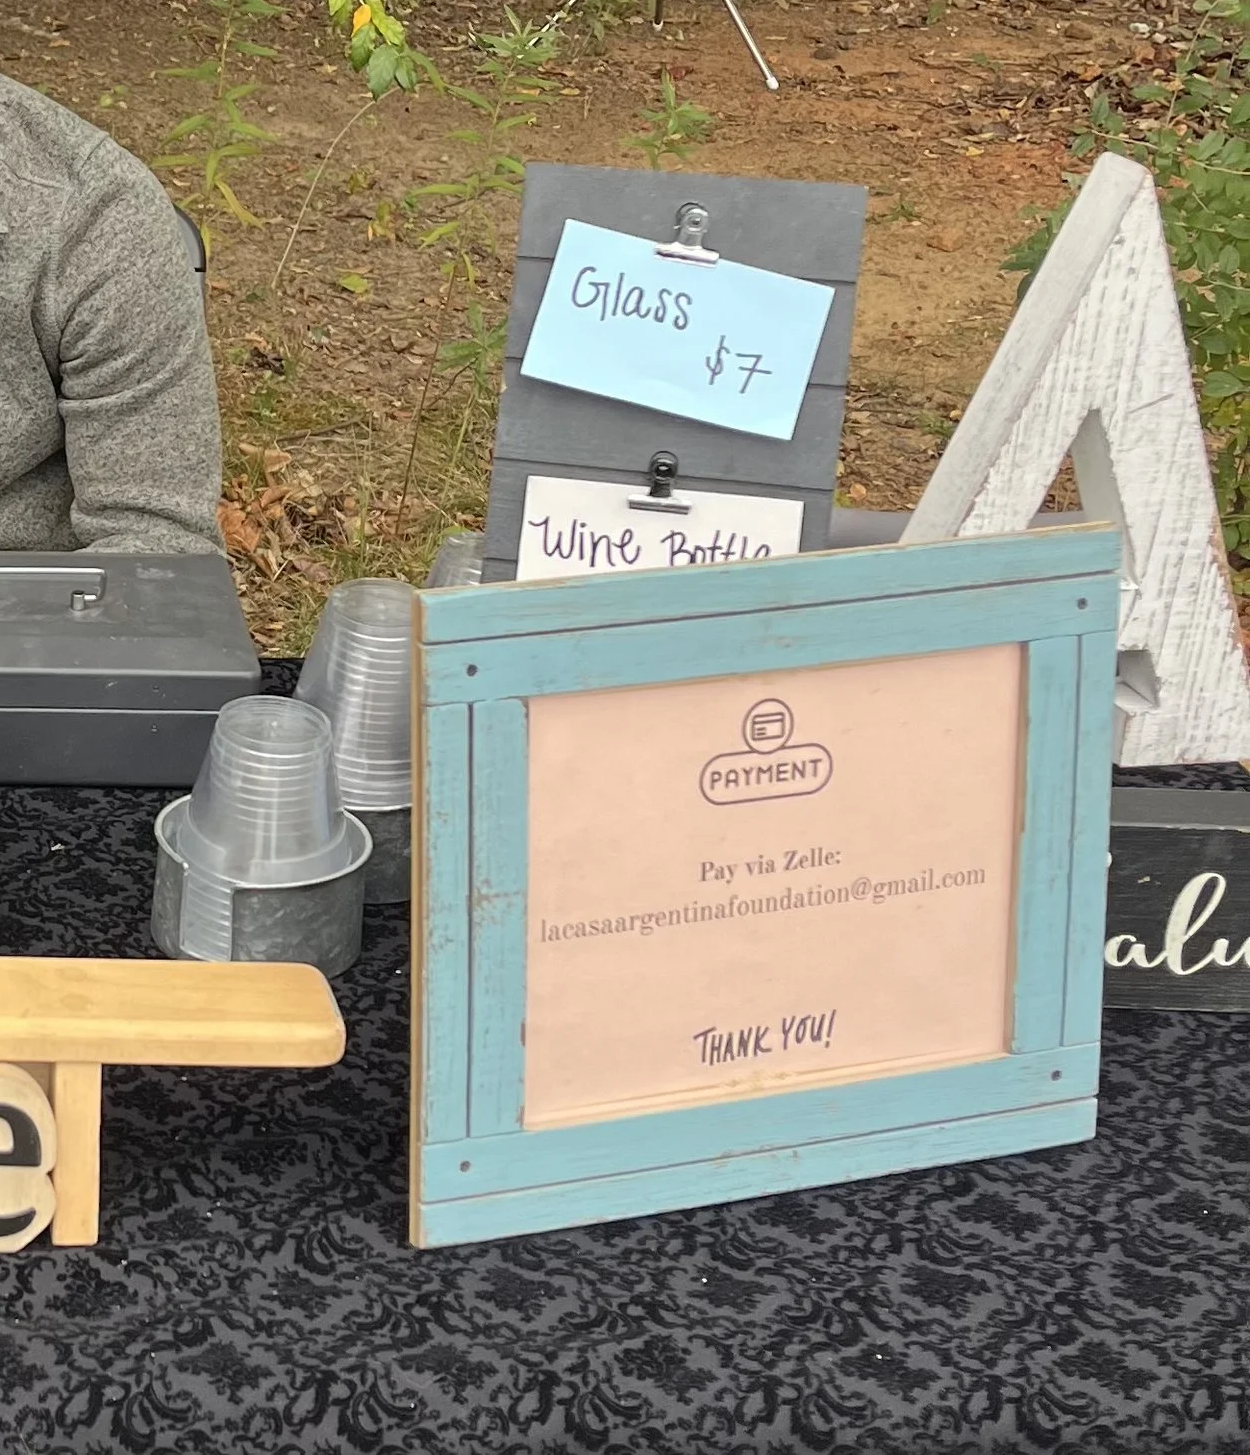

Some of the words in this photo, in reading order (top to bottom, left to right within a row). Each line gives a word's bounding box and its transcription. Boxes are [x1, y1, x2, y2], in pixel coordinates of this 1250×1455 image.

[571, 266, 693, 331] Glass
[705, 335, 773, 394] $7
[528, 516, 641, 568] Wine
[710, 759, 822, 790] PAYMENT
[699, 861, 737, 884] Pay
[745, 854, 776, 876] via
[784, 847, 841, 871] Zelle:
[541, 867, 986, 943] lacasaargentinafoundation@gmail.com
[693, 1026, 771, 1066] THANK
[781, 1009, 837, 1048] YOU!
